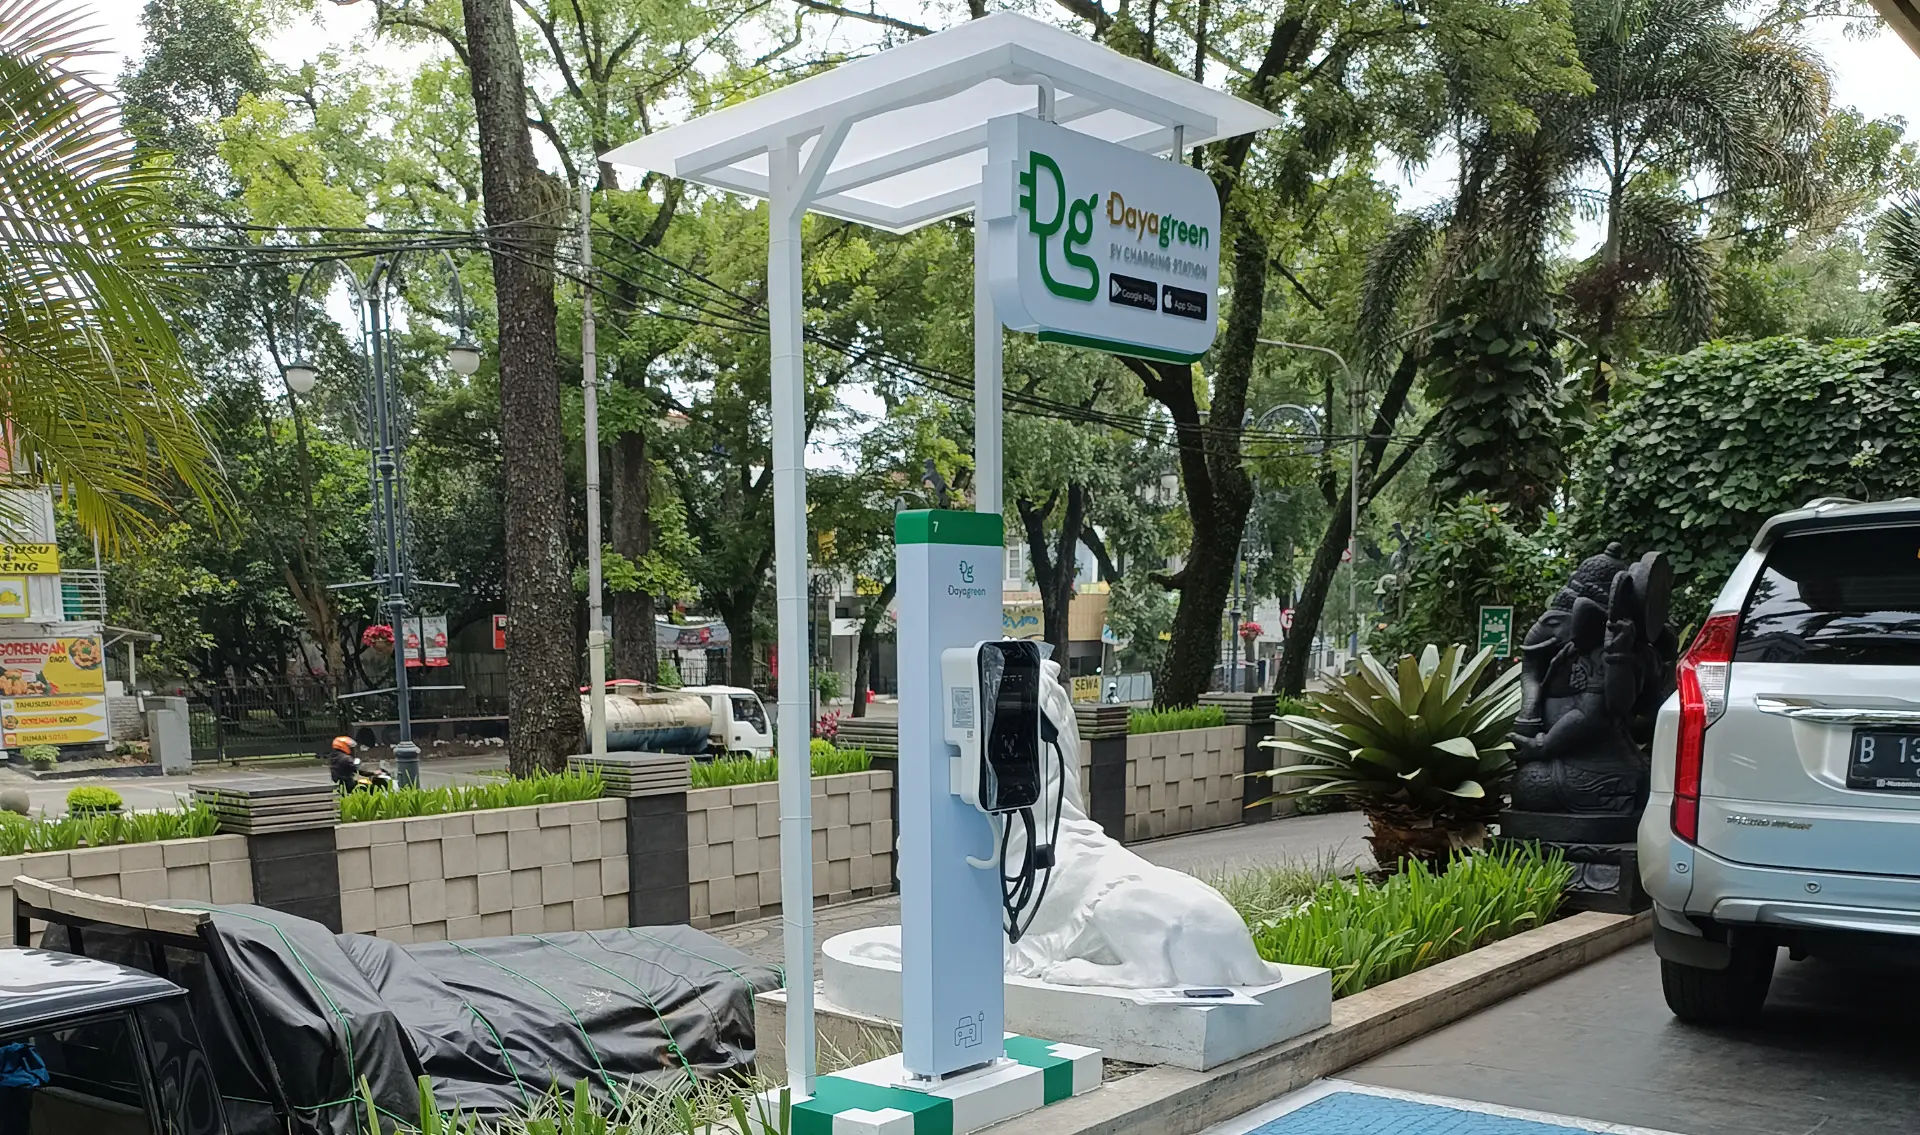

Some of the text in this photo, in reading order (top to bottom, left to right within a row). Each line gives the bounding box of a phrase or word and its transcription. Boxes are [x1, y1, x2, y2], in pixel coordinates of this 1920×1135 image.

[1107, 191, 1209, 249] Dayagreen
[1124, 246, 1171, 273] CHARGING
[1173, 258, 1208, 281] STATION
[1122, 288, 1156, 306] Google Play
[1174, 300, 1202, 313] App Store
[932, 521, 939, 533] 7
[0, 563, 38, 571] ENG
[948, 584, 986, 598] Dayagreen
[0, 642, 66, 656] GORENGAN
[1075, 678, 1099, 691] SEWA
[1860, 736, 1875, 762] B
